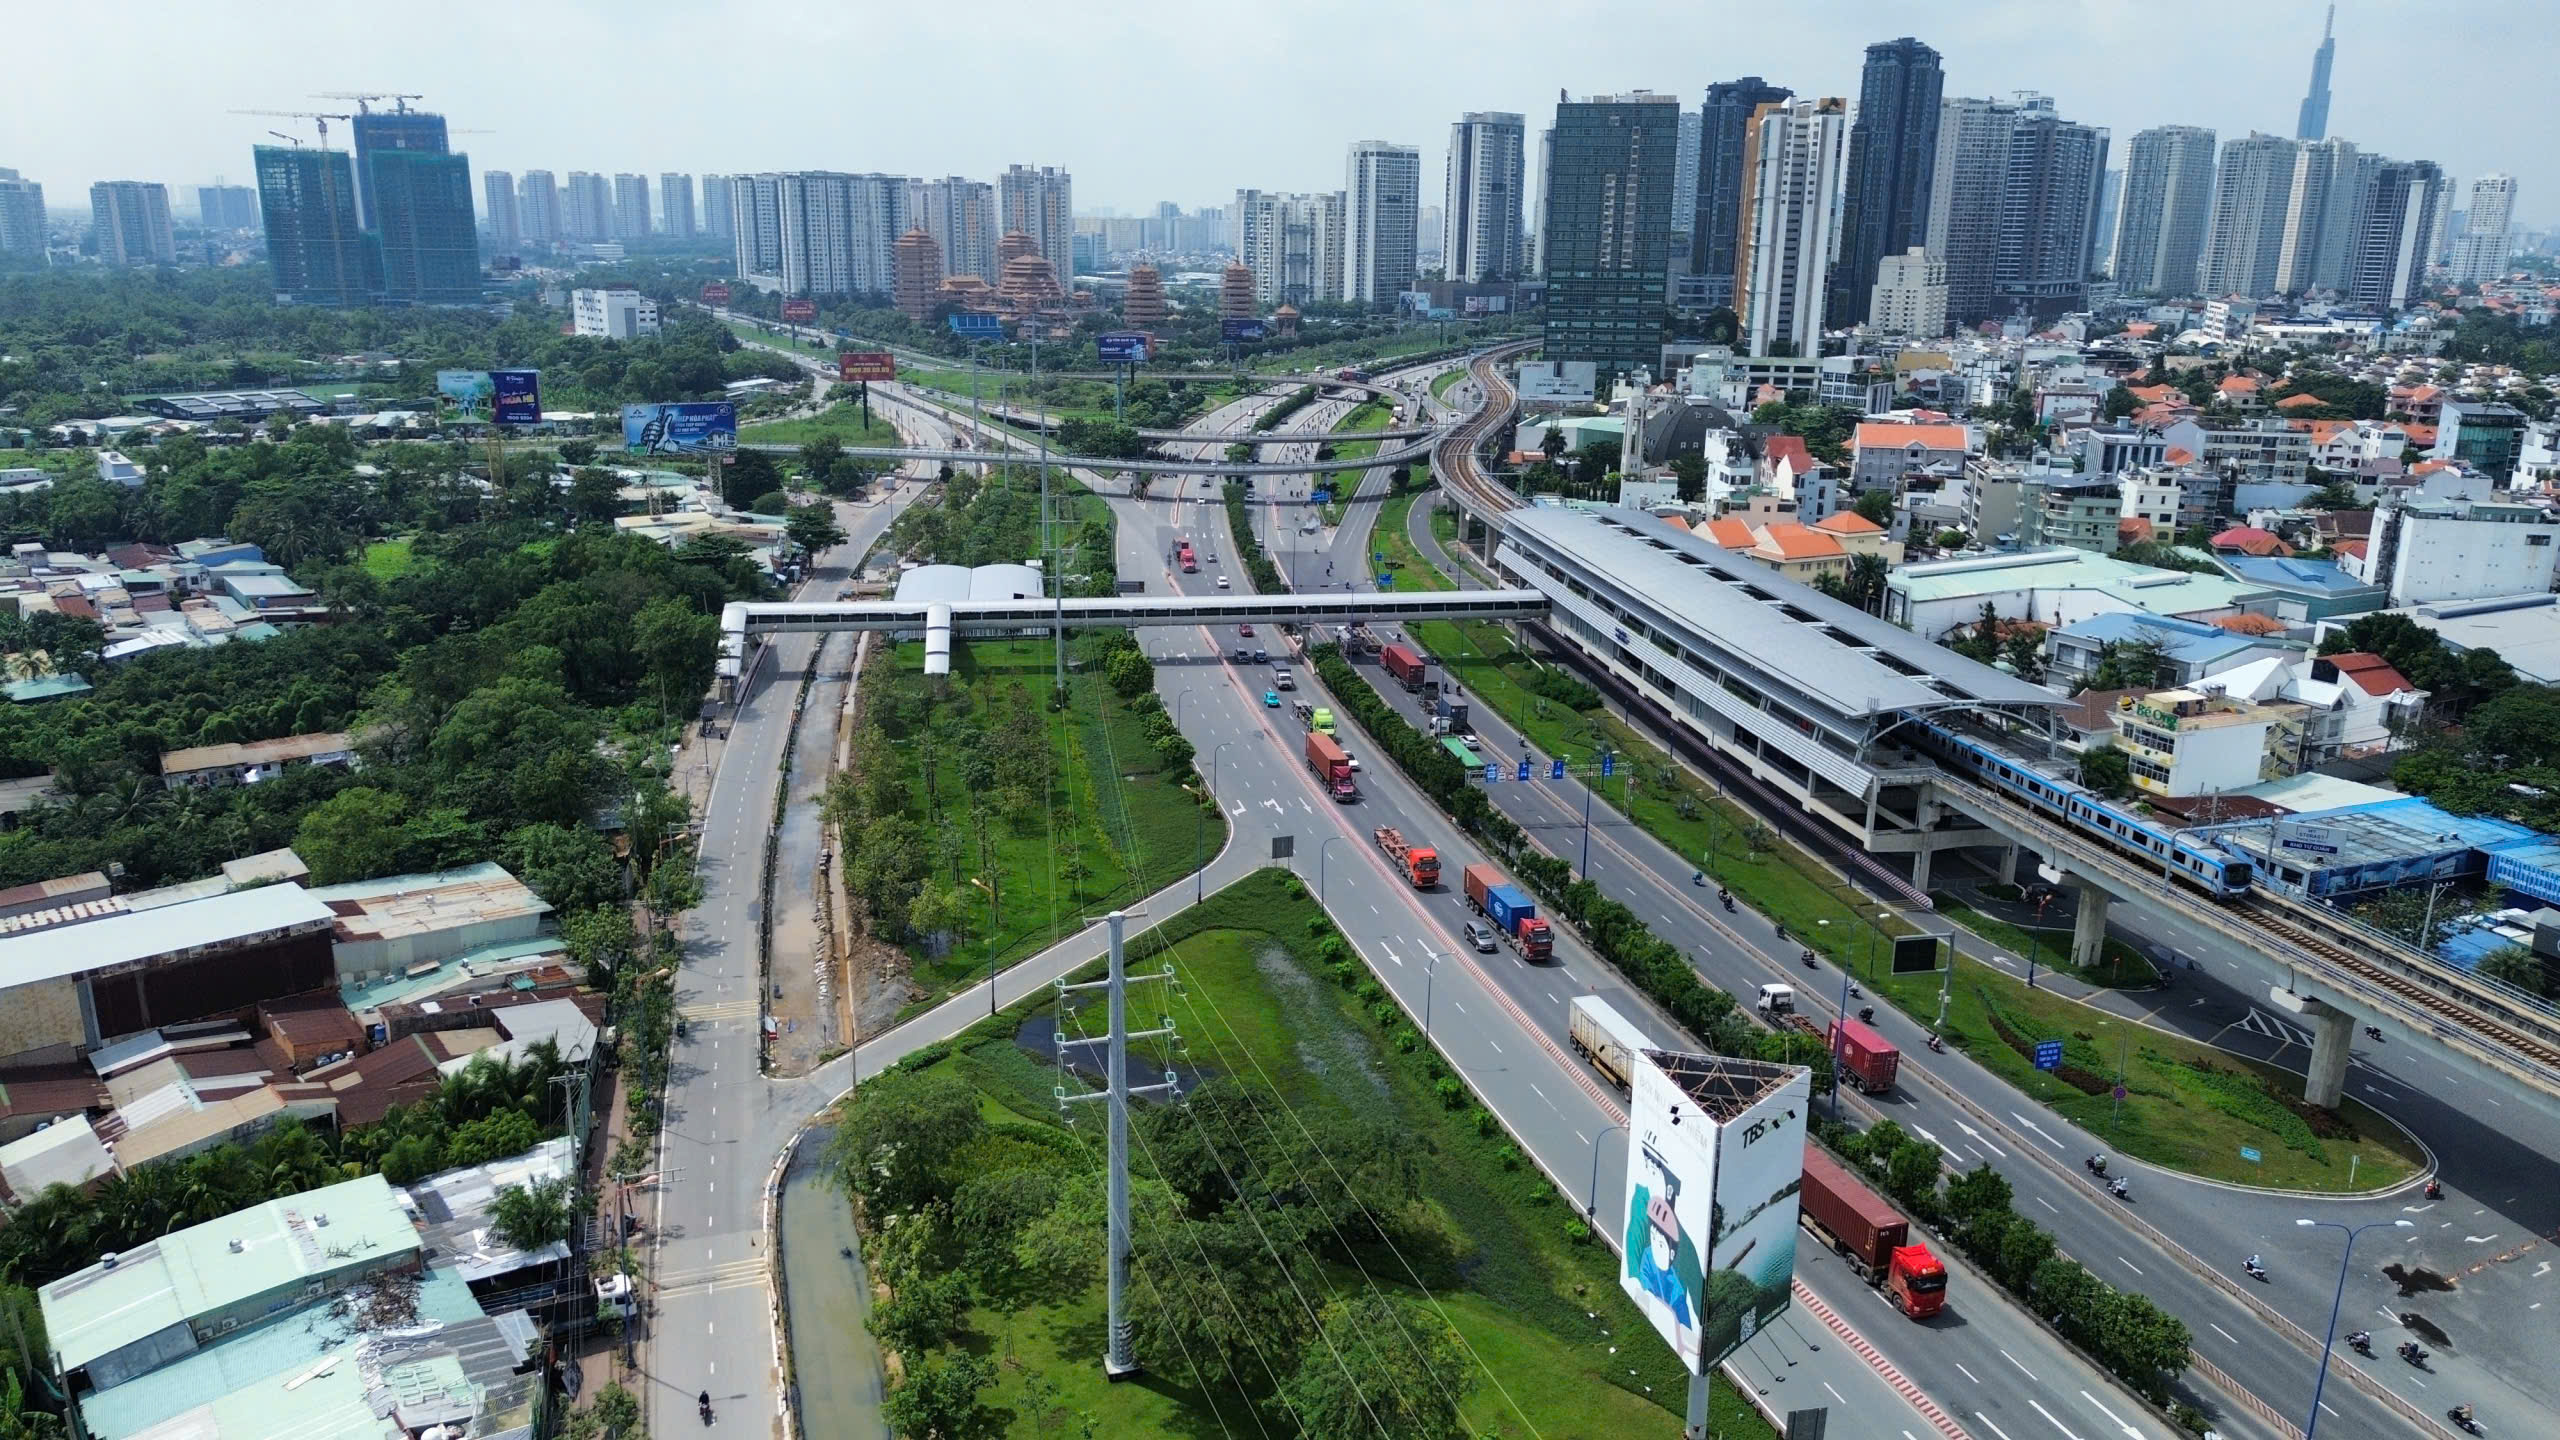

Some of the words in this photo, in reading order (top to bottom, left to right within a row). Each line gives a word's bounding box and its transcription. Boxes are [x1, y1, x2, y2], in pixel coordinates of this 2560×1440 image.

[2137, 704, 2152, 717] Bé
[2153, 709, 2177, 731] Ong
[1743, 1118, 1765, 1149] TBS
